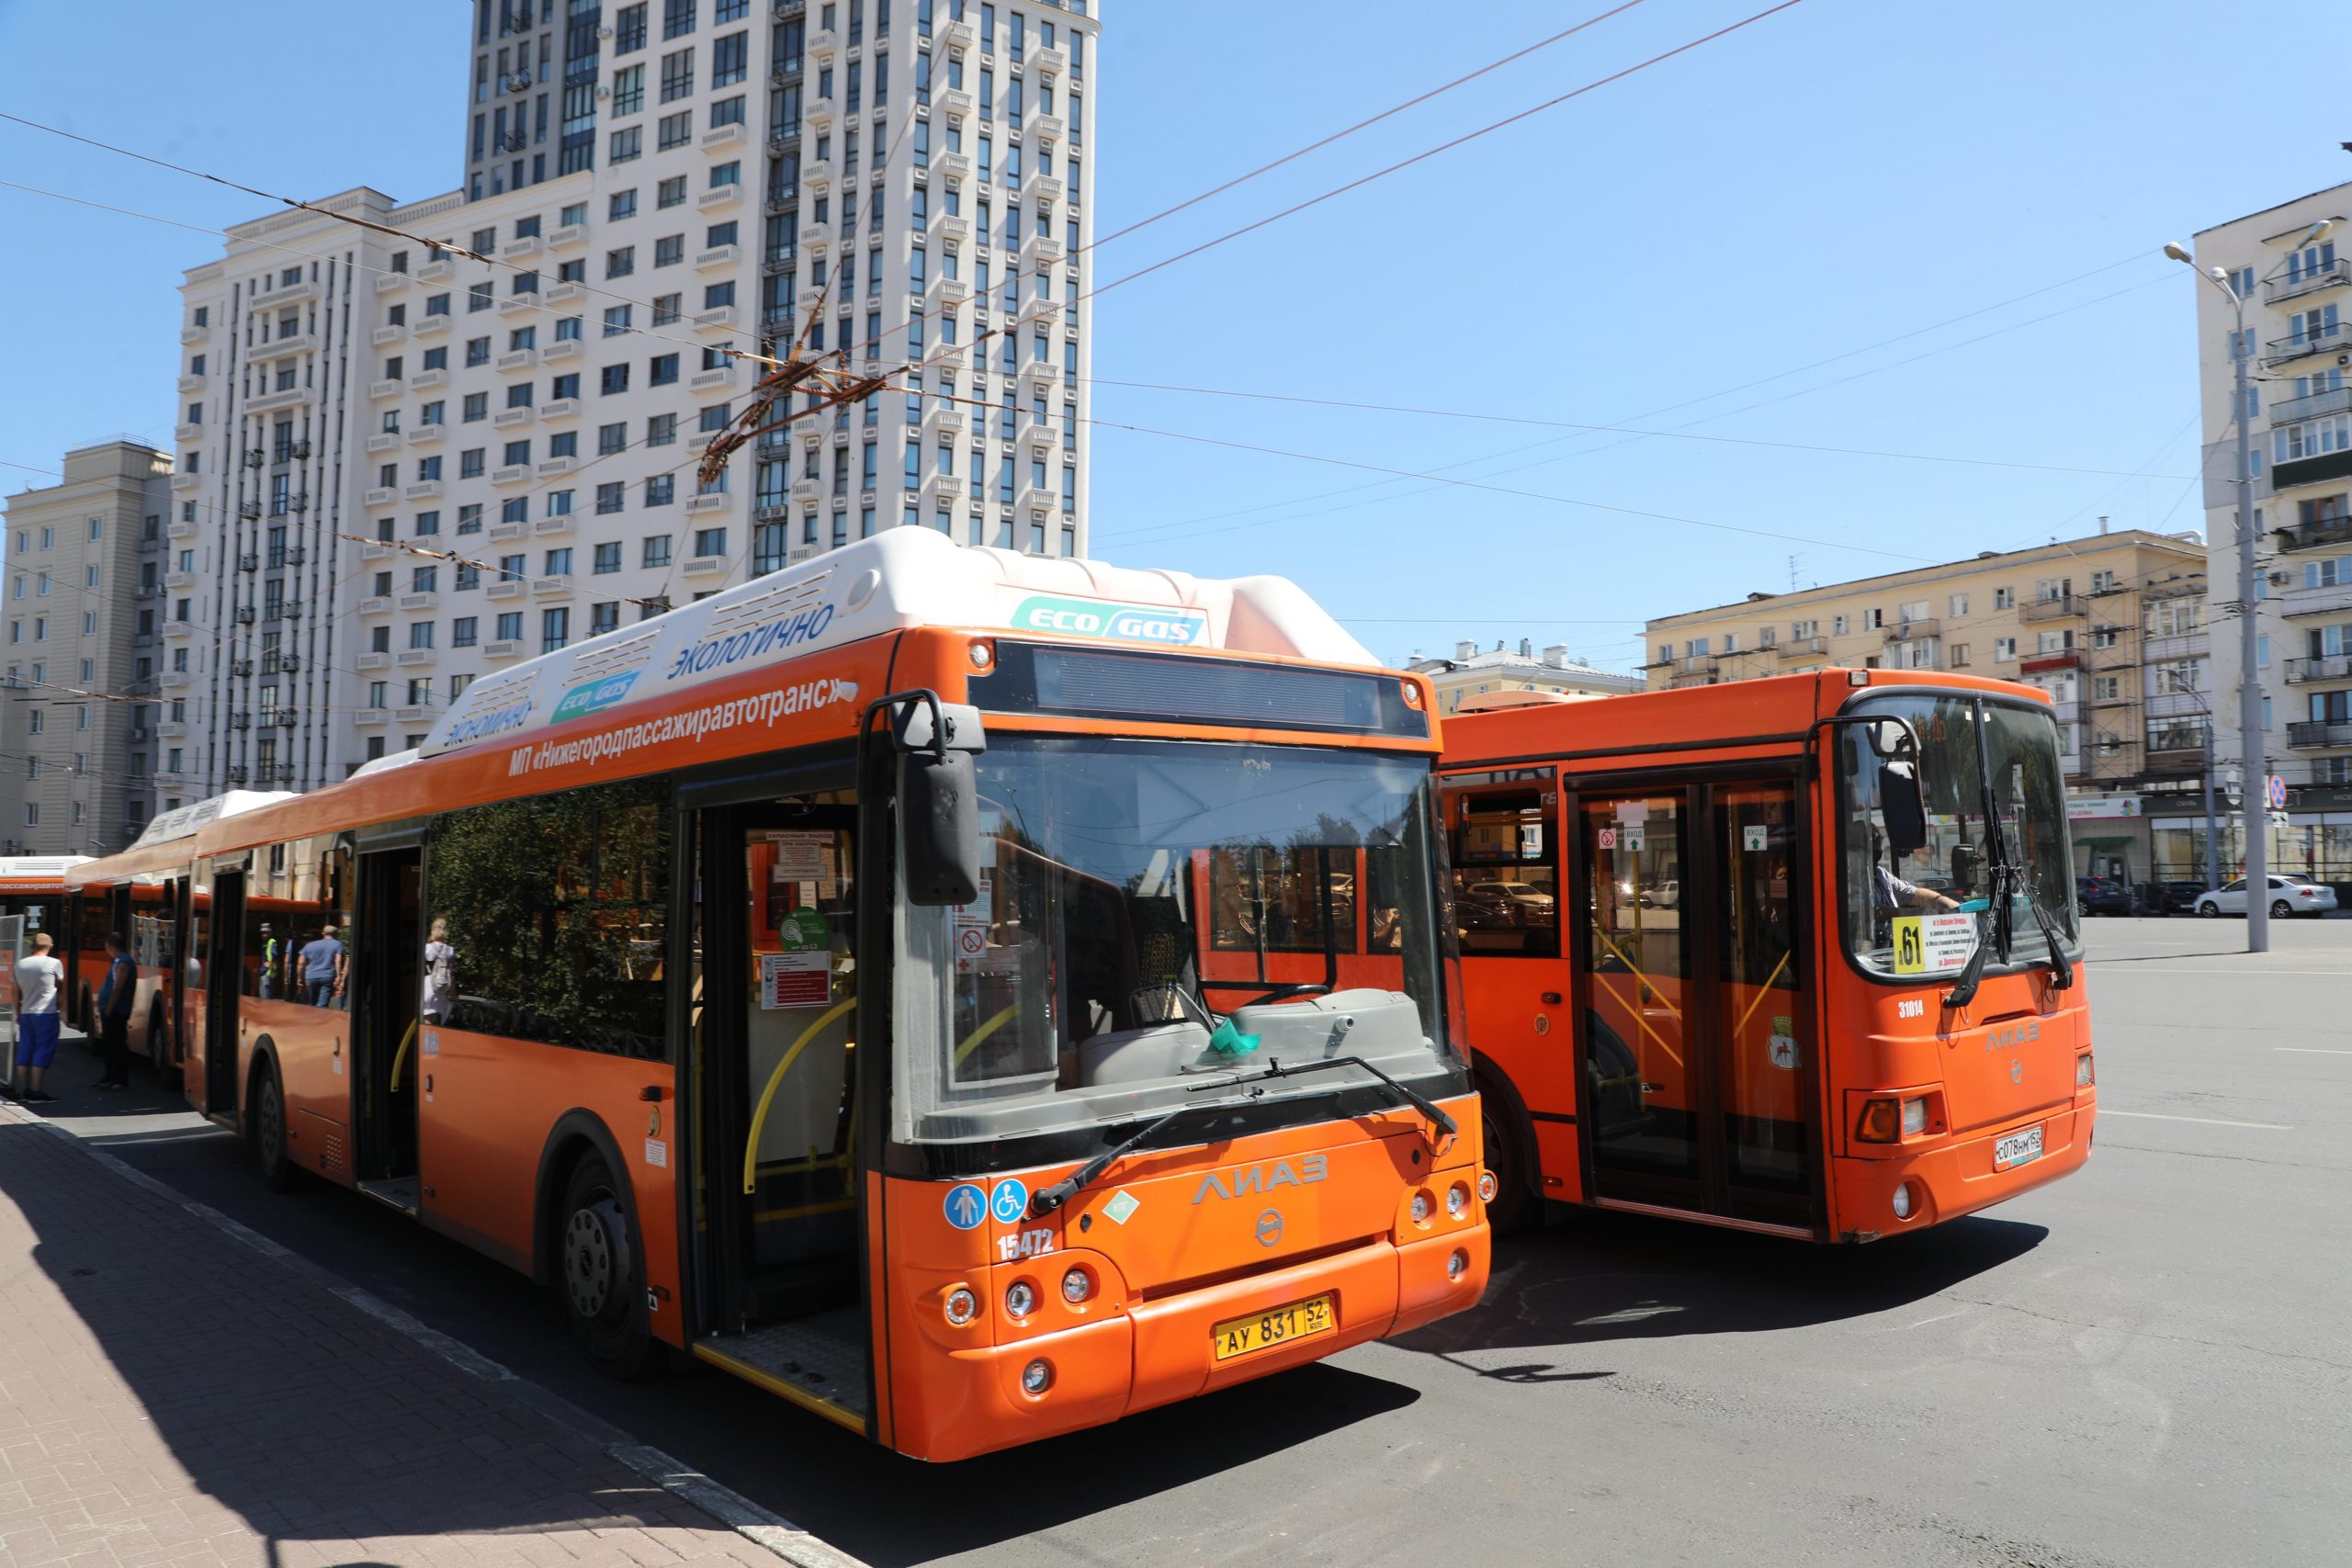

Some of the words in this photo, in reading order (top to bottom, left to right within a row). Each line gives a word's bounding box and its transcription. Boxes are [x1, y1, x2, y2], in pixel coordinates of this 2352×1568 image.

[667, 604, 834, 680] ЭКОЛОГИЧНО
[508, 746, 534, 777] МП
[533, 678, 840, 770] «Нижегородпассажиравтотранс»
[1747, 829, 1764, 837] ВХОД
[1898, 999, 1925, 1019] 31014
[1985, 1022, 2040, 1052] ЛИАЗ
[1191, 1155, 1328, 1205] ЛИАЗ
[997, 1228, 1055, 1261] 15472
[1227, 1327, 1250, 1353] АУ
[1261, 1309, 1296, 1342] 831
[1306, 1301, 1324, 1322] 52
[1309, 1321, 1324, 1330] RUS
